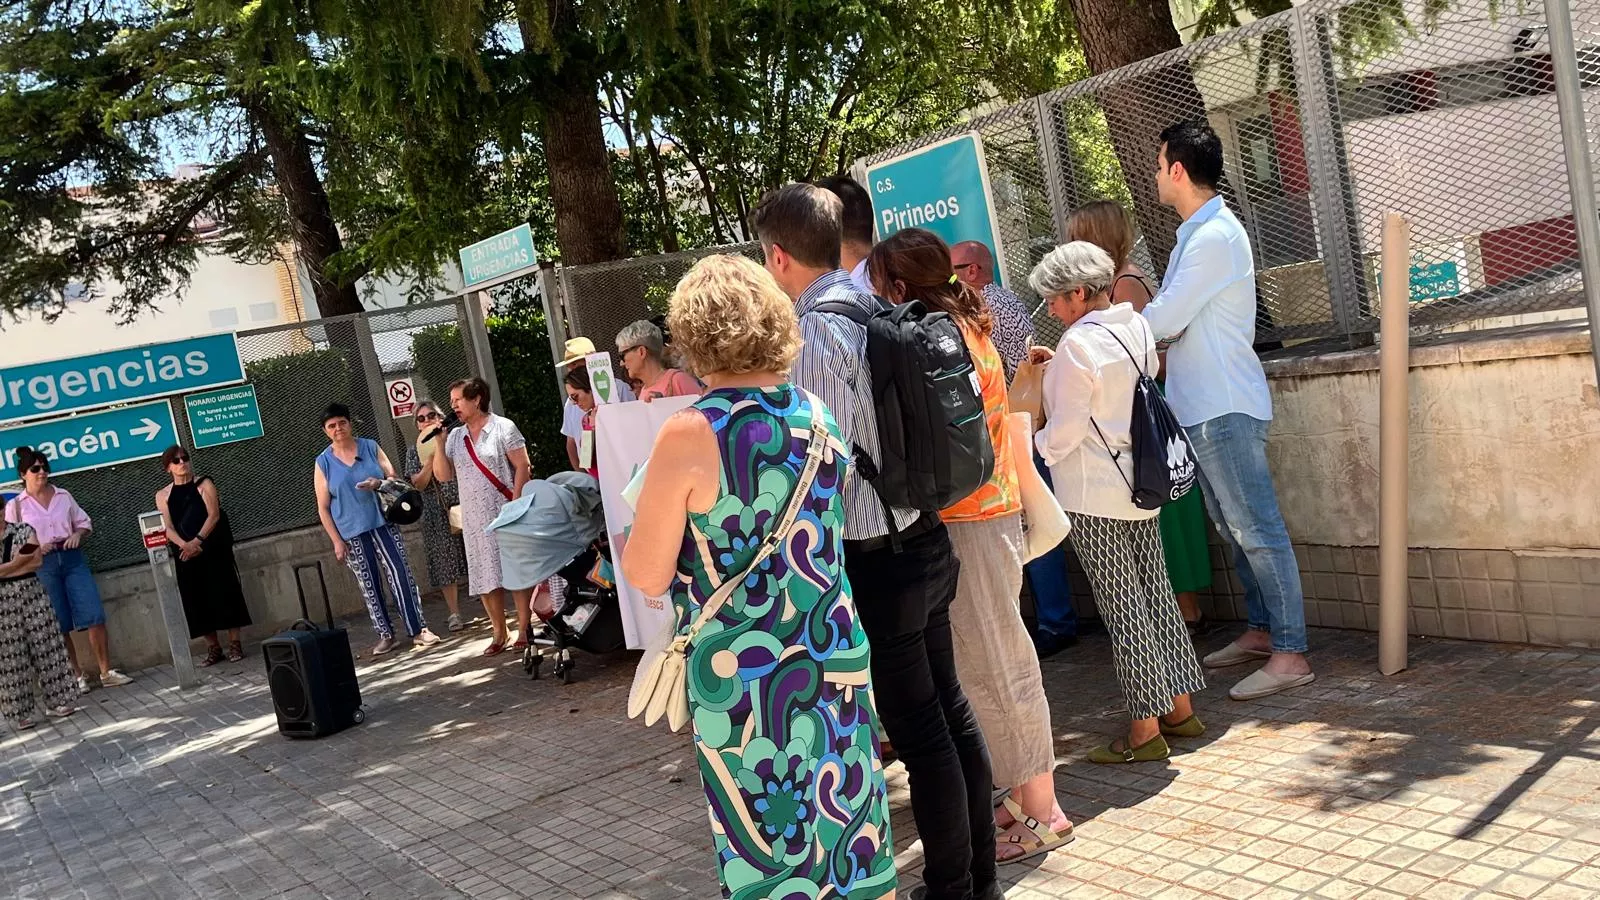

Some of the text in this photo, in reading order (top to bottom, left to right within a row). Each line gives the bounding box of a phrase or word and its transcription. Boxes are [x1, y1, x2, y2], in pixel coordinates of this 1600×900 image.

[876, 177, 895, 193] C.S.
[881, 195, 960, 234] Pirineos
[471, 233, 520, 262] ENTRADA
[469, 248, 529, 280] URGENCIAS
[0, 350, 209, 410] rgencias
[188, 390, 253, 407] HORARIO URGENCIAS
[206, 407, 222, 415] lunes
